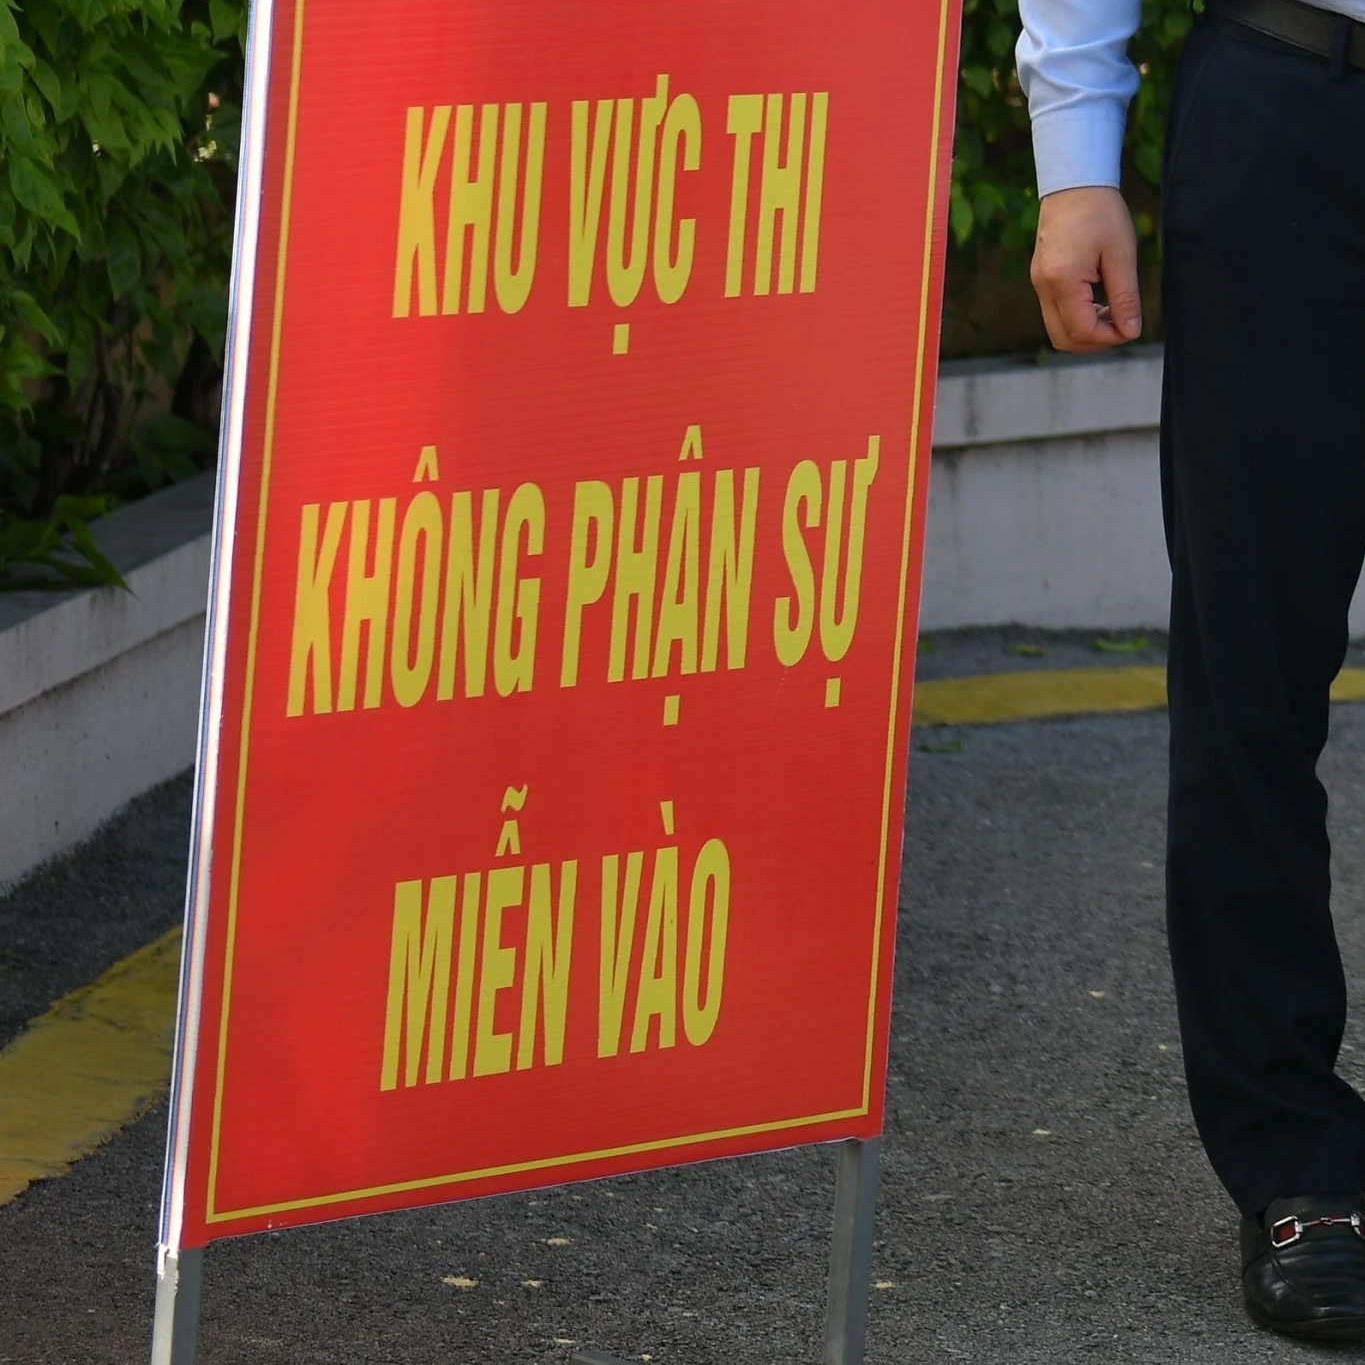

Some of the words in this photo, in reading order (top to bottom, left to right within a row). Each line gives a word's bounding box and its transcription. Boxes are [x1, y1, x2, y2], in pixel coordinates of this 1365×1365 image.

[392, 102, 548, 318] KHU
[567, 74, 702, 355] VỰC
[724, 92, 830, 298] THI
[286, 446, 547, 718] KHÔNG
[559, 424, 761, 726] PHẬN
[773, 435, 880, 708] SỰ
[379, 785, 578, 1092] MIỄN
[597, 800, 732, 1058] VÀO
